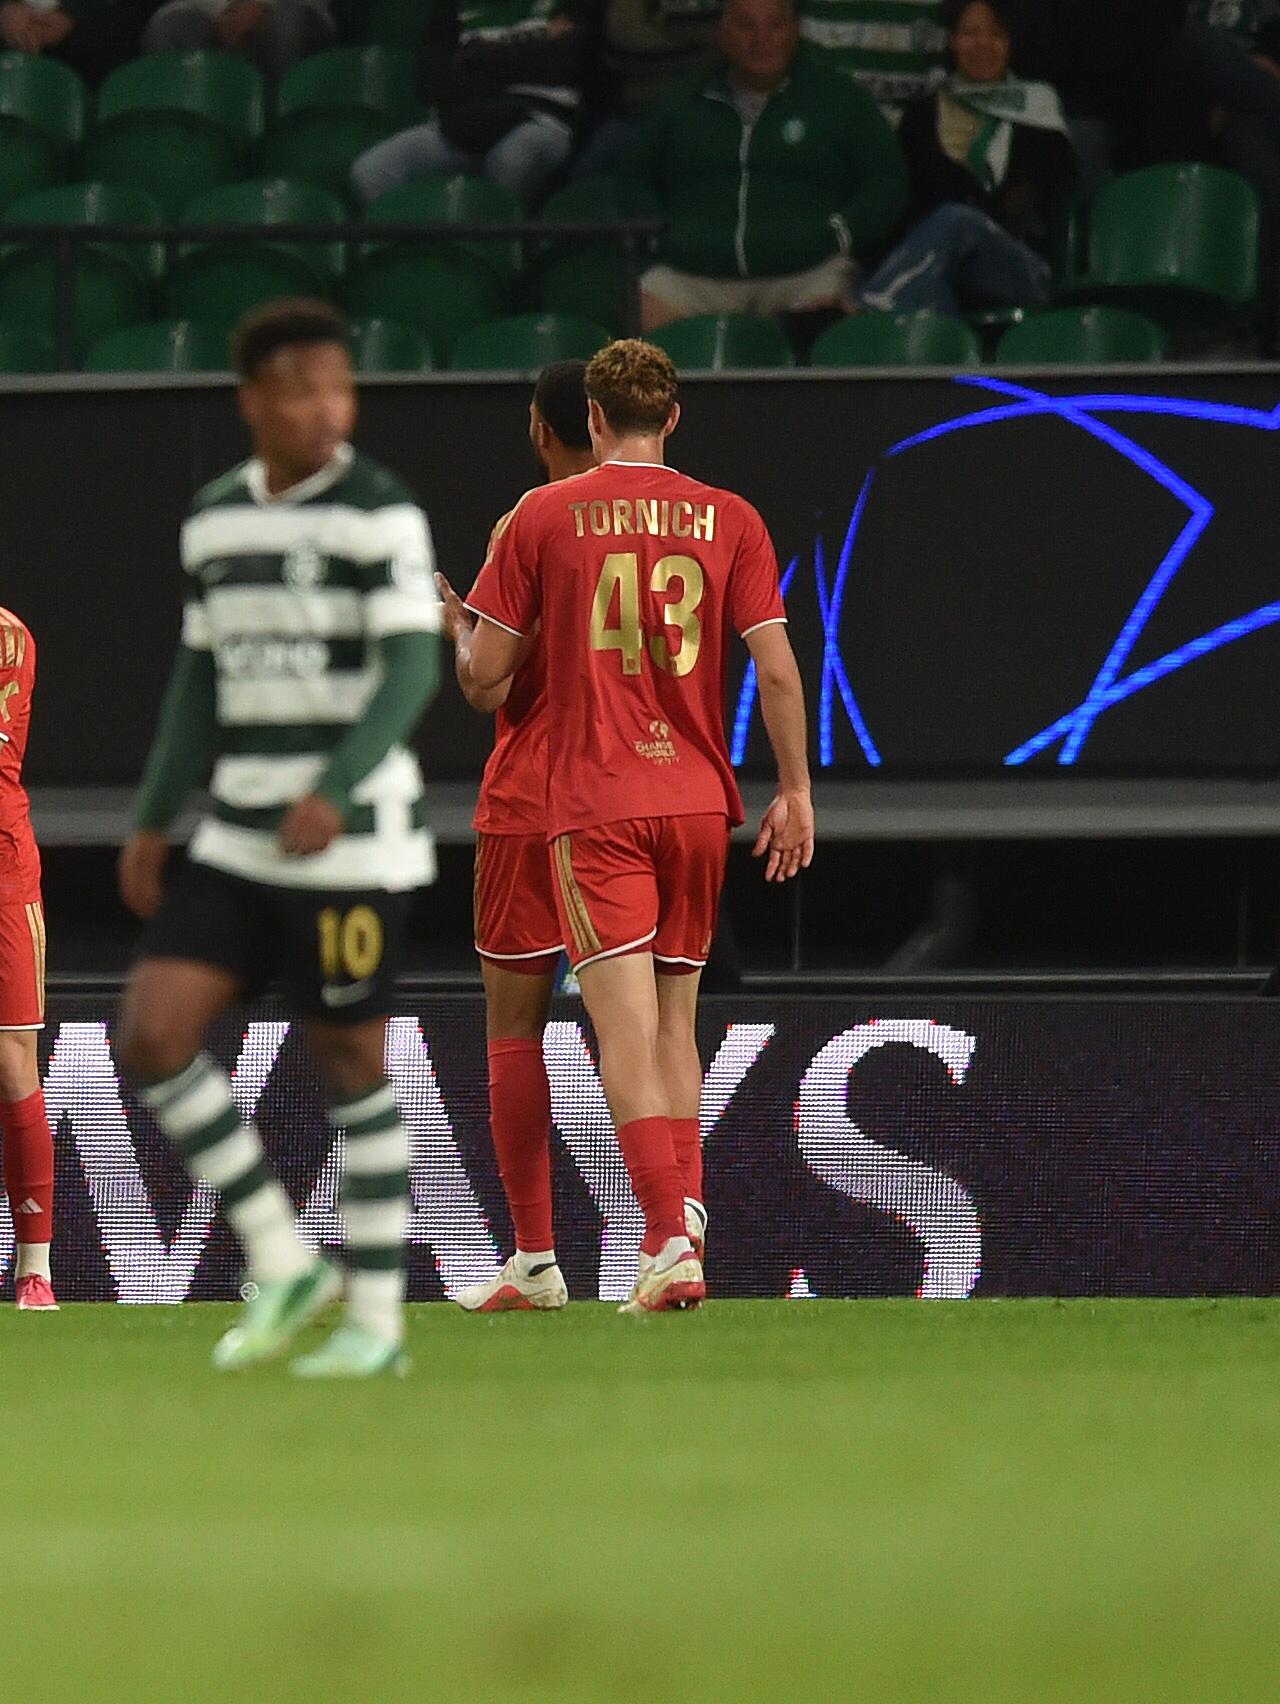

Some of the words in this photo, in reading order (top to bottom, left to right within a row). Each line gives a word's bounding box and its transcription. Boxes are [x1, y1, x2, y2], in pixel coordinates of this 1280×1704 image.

[568, 499, 715, 542] TORNICH
[590, 552, 704, 677] 43
[317, 904, 384, 980] 10
